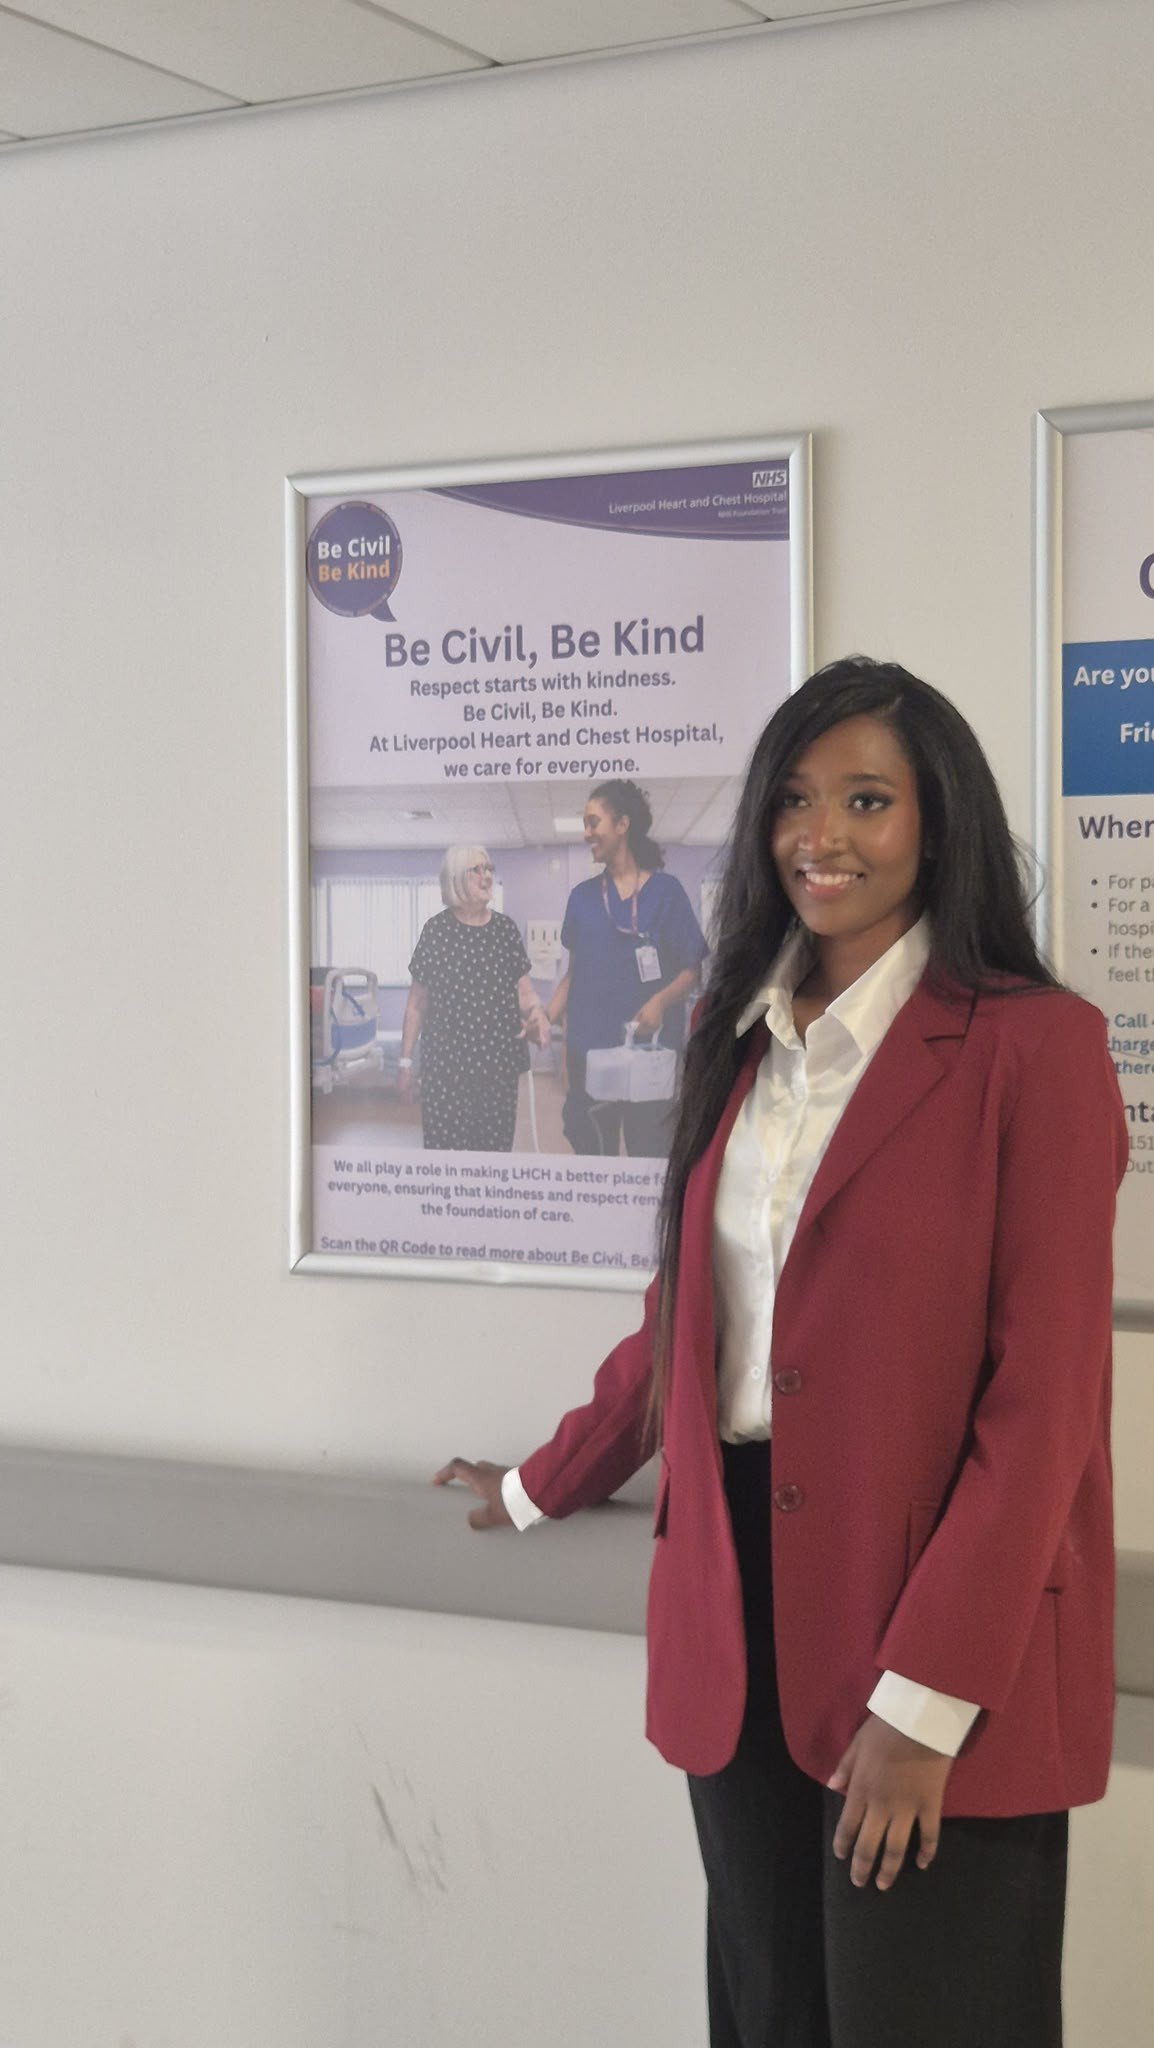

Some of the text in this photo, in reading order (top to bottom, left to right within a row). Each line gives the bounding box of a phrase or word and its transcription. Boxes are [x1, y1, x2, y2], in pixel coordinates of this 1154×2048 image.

[754, 472, 785, 486] NHS
[609, 491, 787, 514] Liverpool Heart and Chest Hospital
[318, 535, 390, 559] Be Civil
[319, 559, 390, 582] Be Kind
[386, 615, 704, 669] Be Civil, Be Kind
[410, 669, 676, 699] Respect starts with kindness.
[1073, 666, 1154, 689] Are yo
[463, 699, 618, 723] Be Civil, Be Kind.
[369, 723, 724, 755] At Liverpool Heart and Chest Hospital,
[1120, 722, 1154, 743] Fri
[444, 757, 640, 778] we care for everyone.
[1108, 875, 1136, 889] For
[1108, 898, 1150, 912] For a
[1108, 943, 1154, 959] If the
[1108, 967, 1139, 982] feel
[1114, 1013, 1147, 1028] Call
[334, 1160, 666, 1187] We all play a role in making LHCH a better place fo
[328, 1181, 391, 1196] everyone,
[394, 1183, 451, 1199] ensuring
[454, 1185, 481, 1198] that
[485, 1186, 544, 1201] kindness
[547, 1189, 573, 1202] and
[577, 1191, 628, 1207] respect
[421, 1202, 574, 1222] the foundation of care.
[321, 1237, 351, 1249] Scan
[355, 1238, 377, 1251] the
[380, 1240, 399, 1254] QR
[402, 1241, 436, 1255] Code
[439, 1243, 453, 1256] to
[456, 1244, 486, 1258] read
[489, 1248, 525, 1259] more
[528, 1248, 568, 1262] about
[571, 1250, 589, 1264] Be
[592, 1251, 627, 1268] Civil,
[631, 1254, 649, 1267] Be
